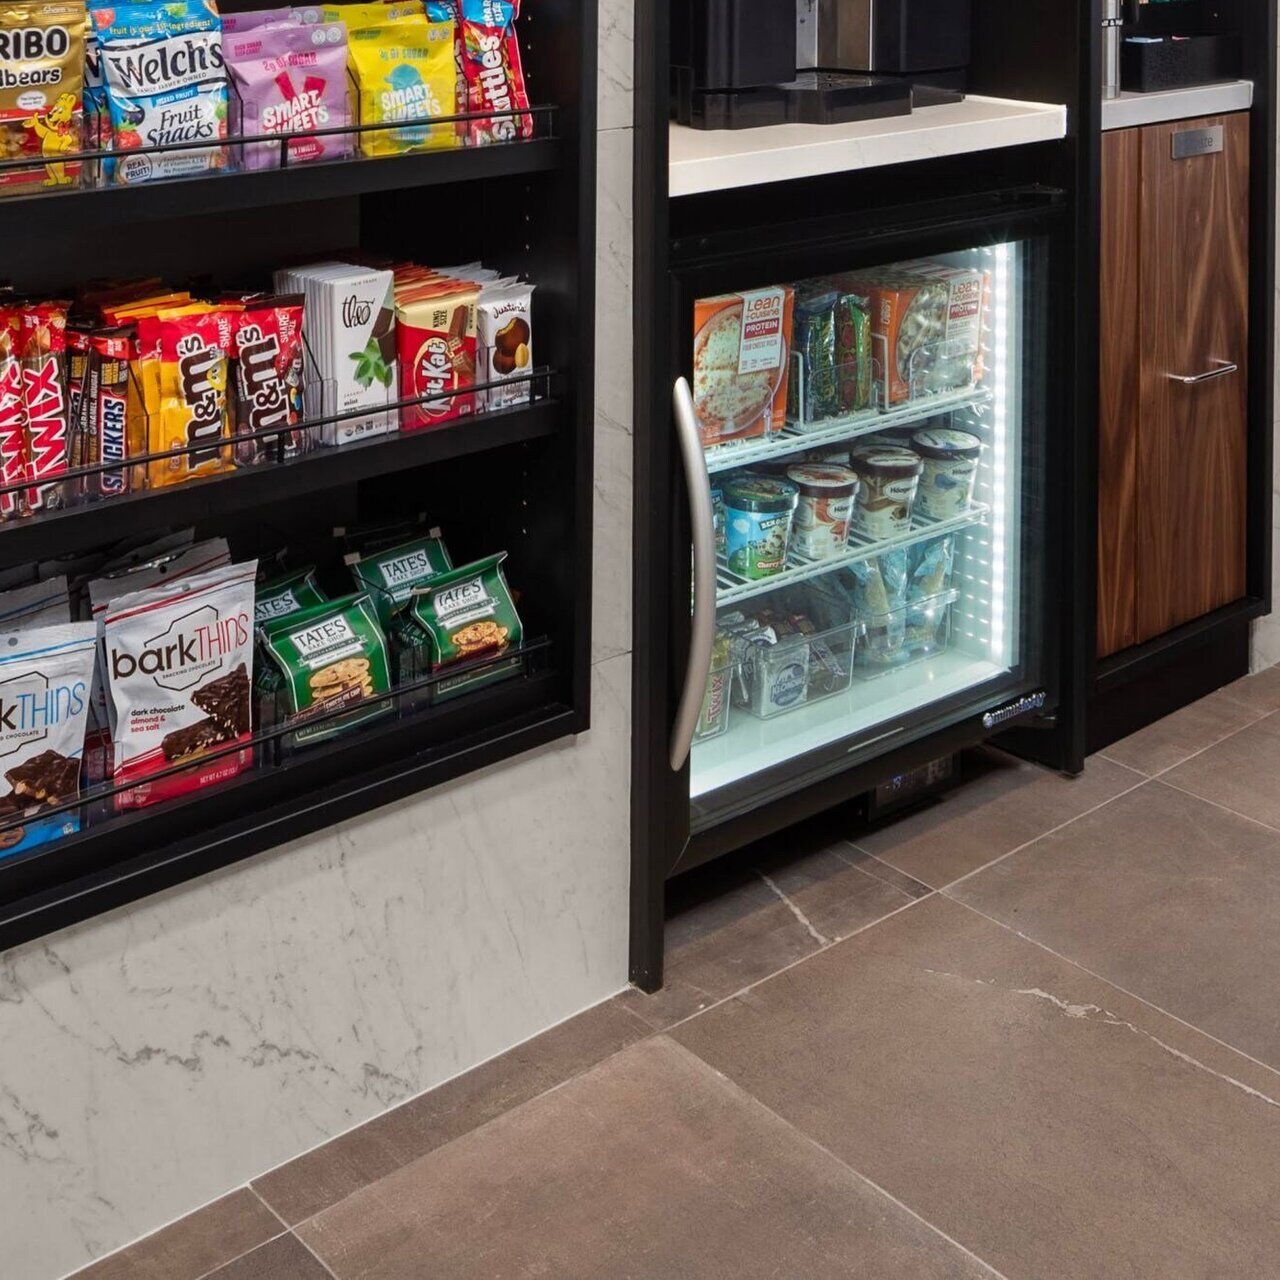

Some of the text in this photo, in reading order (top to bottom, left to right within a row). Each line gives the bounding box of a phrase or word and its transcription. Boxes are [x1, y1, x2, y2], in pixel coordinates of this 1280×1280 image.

[109, 39, 223, 89] Welch's
[381, 84, 432, 107] SMART
[161, 104, 203, 131] Fruit
[263, 91, 321, 125] SMART
[147, 122, 213, 146] Snacks
[126, 160, 146, 169] REAL
[342, 294, 374, 328] theo
[493, 303, 528, 320] Justin's
[747, 296, 780, 312] Lean
[951, 301, 979, 315] PROTEIN
[218, 319, 229, 347] SHARE
[278, 313, 288, 343] SHARE
[745, 320, 779, 334] PROTEIN
[23, 357, 65, 510] TWIX
[382, 553, 428, 579] TATE'S
[408, 566, 428, 579] SHOP
[436, 580, 482, 607] TATE'S
[294, 618, 348, 649] TATE'S
[308, 642, 323, 652] BAKE
[325, 634, 345, 646] SHOP
[131, 704, 185, 717] dark chocolate
[131, 716, 159, 725] almond
[145, 722, 160, 732] salt
